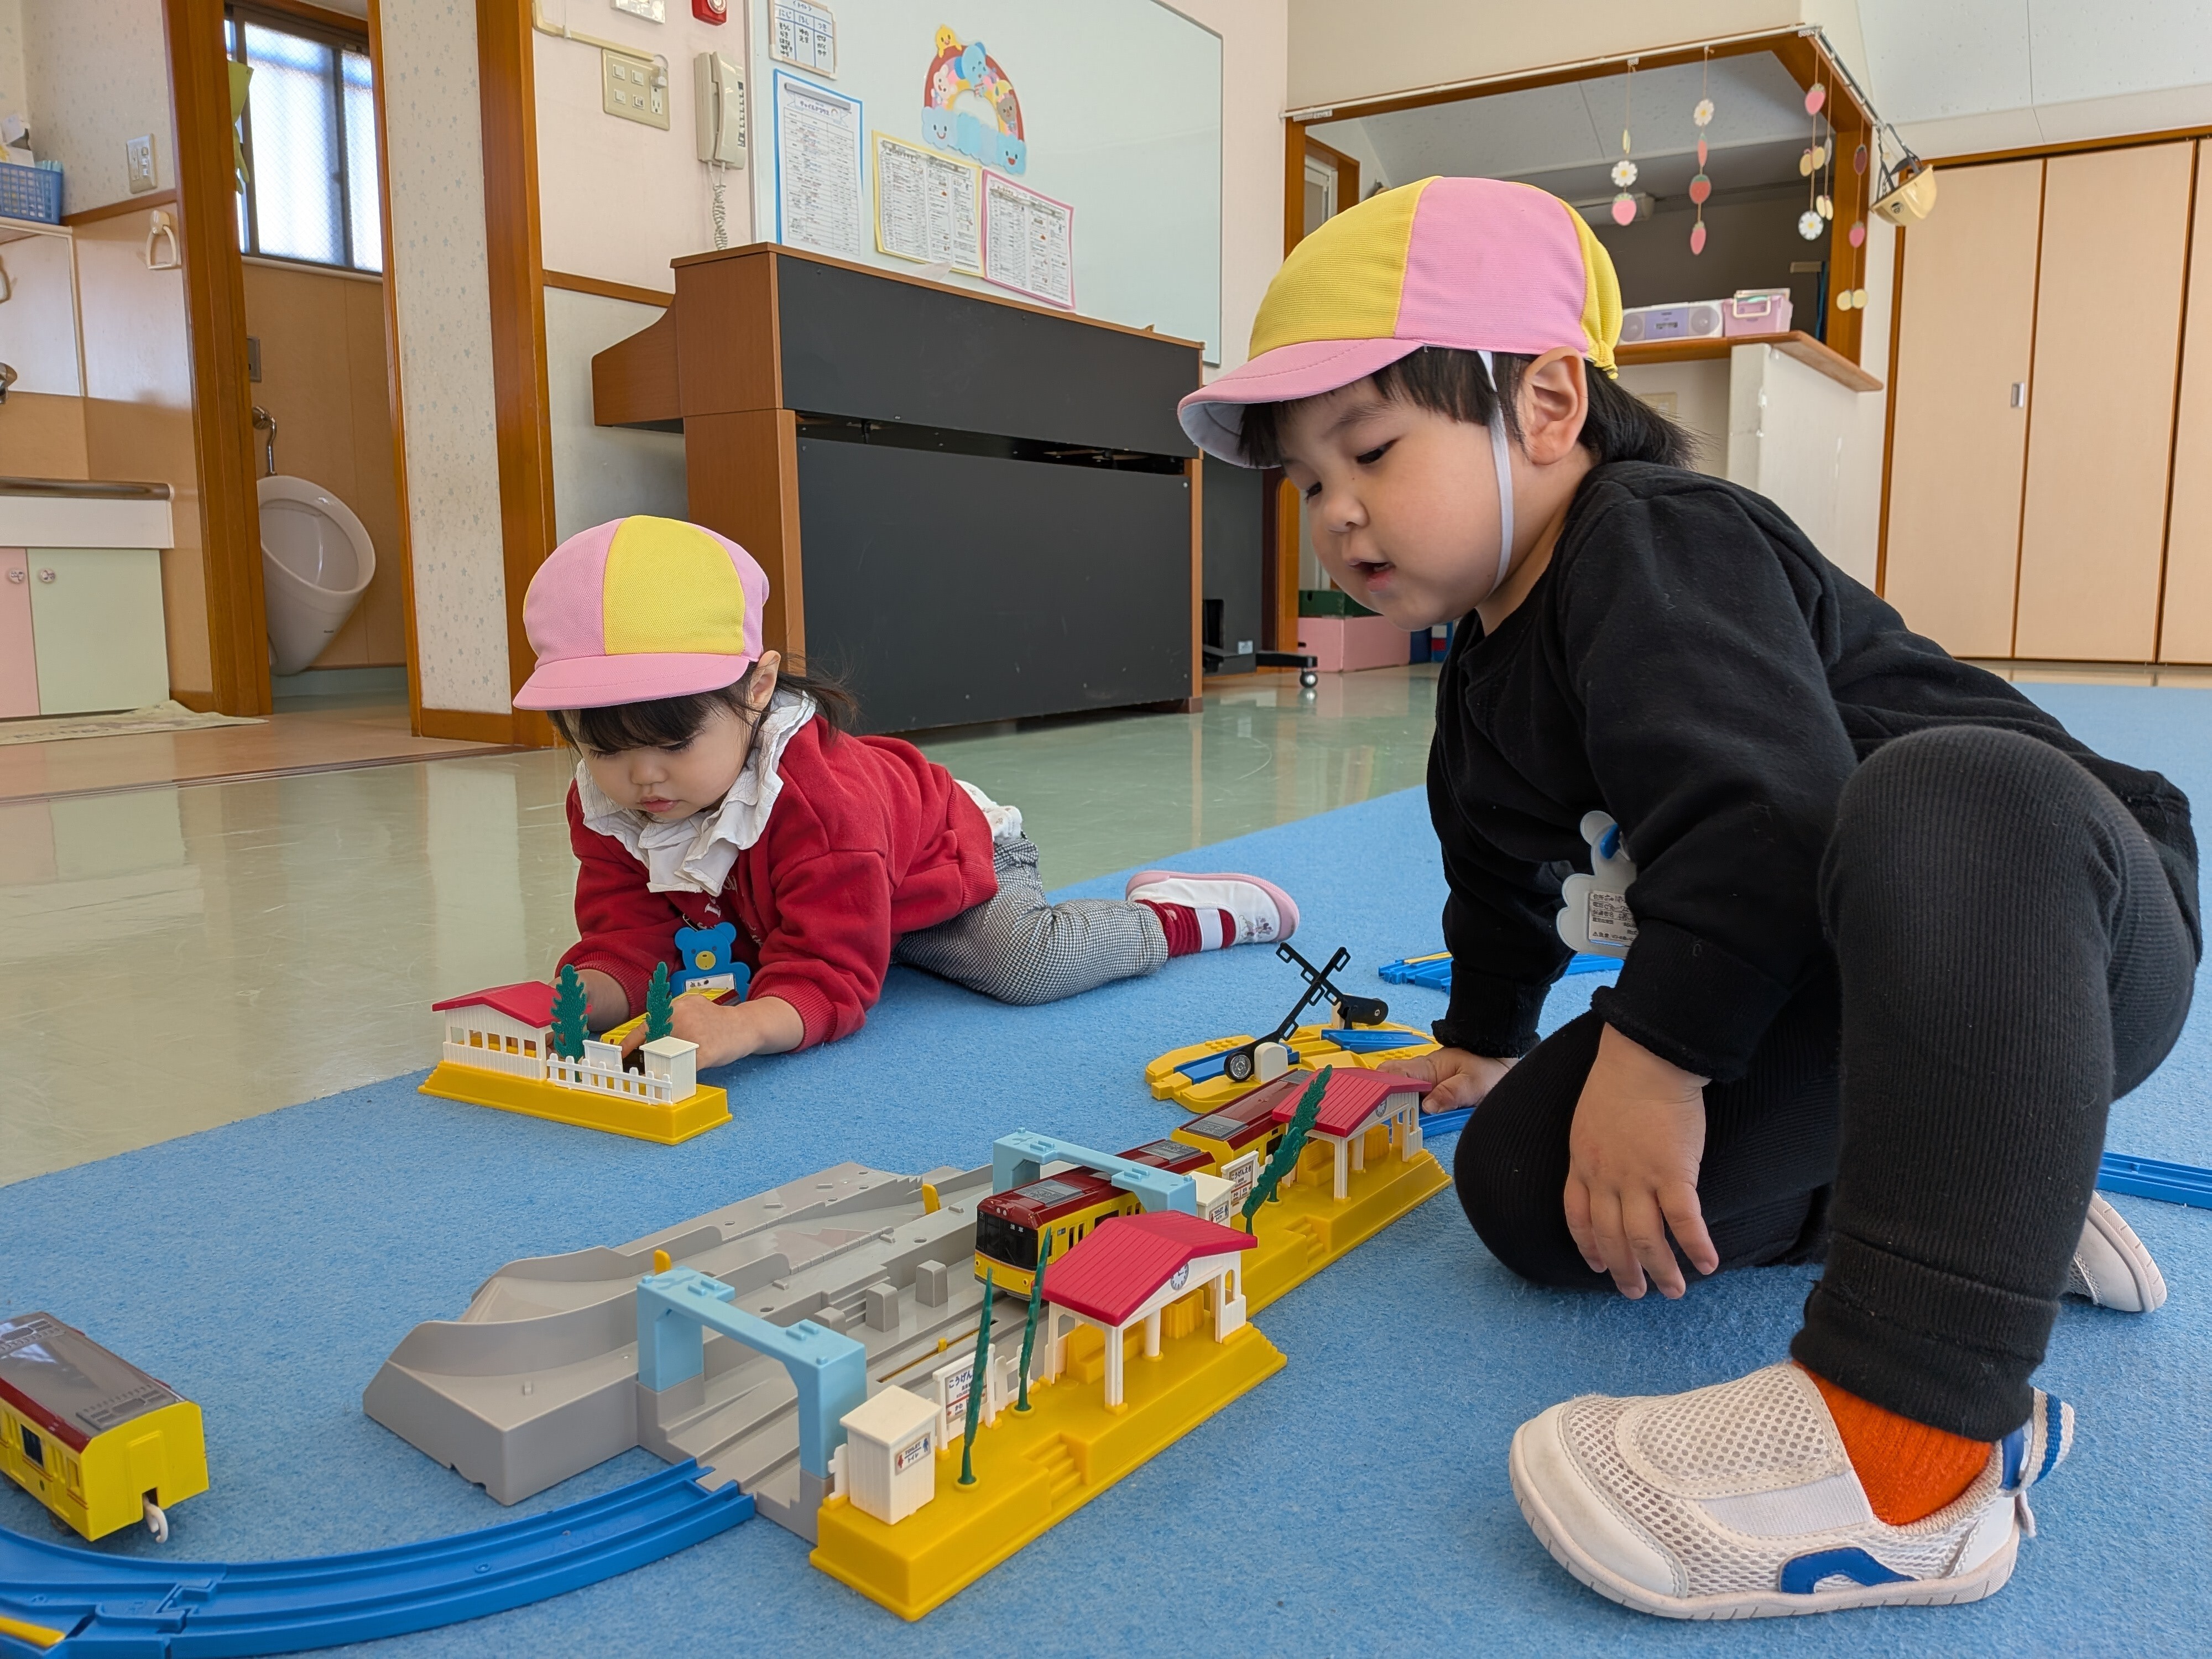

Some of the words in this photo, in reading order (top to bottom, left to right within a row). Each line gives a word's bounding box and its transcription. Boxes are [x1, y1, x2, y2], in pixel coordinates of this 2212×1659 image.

[1232, 1165, 1251, 1181] こうげんえき
[949, 1370, 973, 1389] こうげん
[905, 1441, 921, 1455] TOILET
[907, 1453, 919, 1463] トイレ
